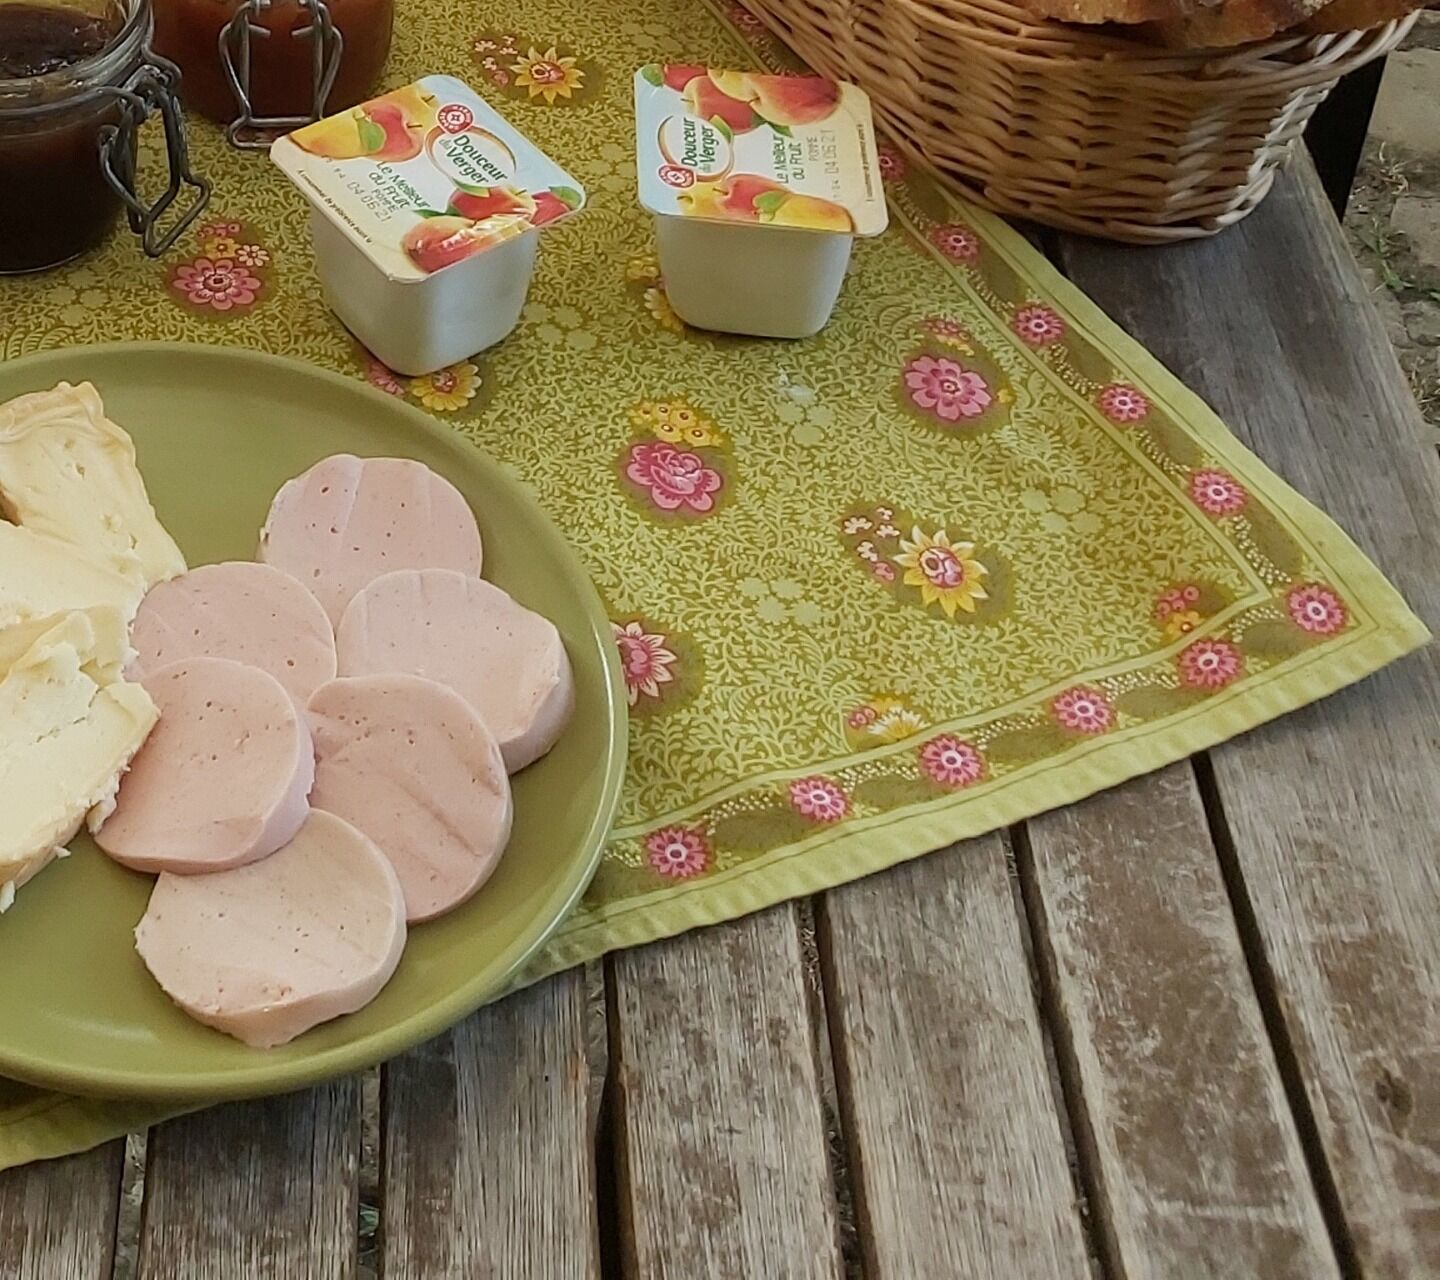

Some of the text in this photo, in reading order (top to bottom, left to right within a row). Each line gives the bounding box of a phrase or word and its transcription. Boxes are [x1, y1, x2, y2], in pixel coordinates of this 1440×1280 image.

[453, 132, 507, 181] Douceur
[681, 118, 697, 167] Douceur
[699, 125, 715, 162] Verger
[789, 143, 805, 166] Fruit
[447, 147, 487, 184] Verger
[368, 169, 410, 209] du Fruit
[389, 173, 429, 207] Meilleur
